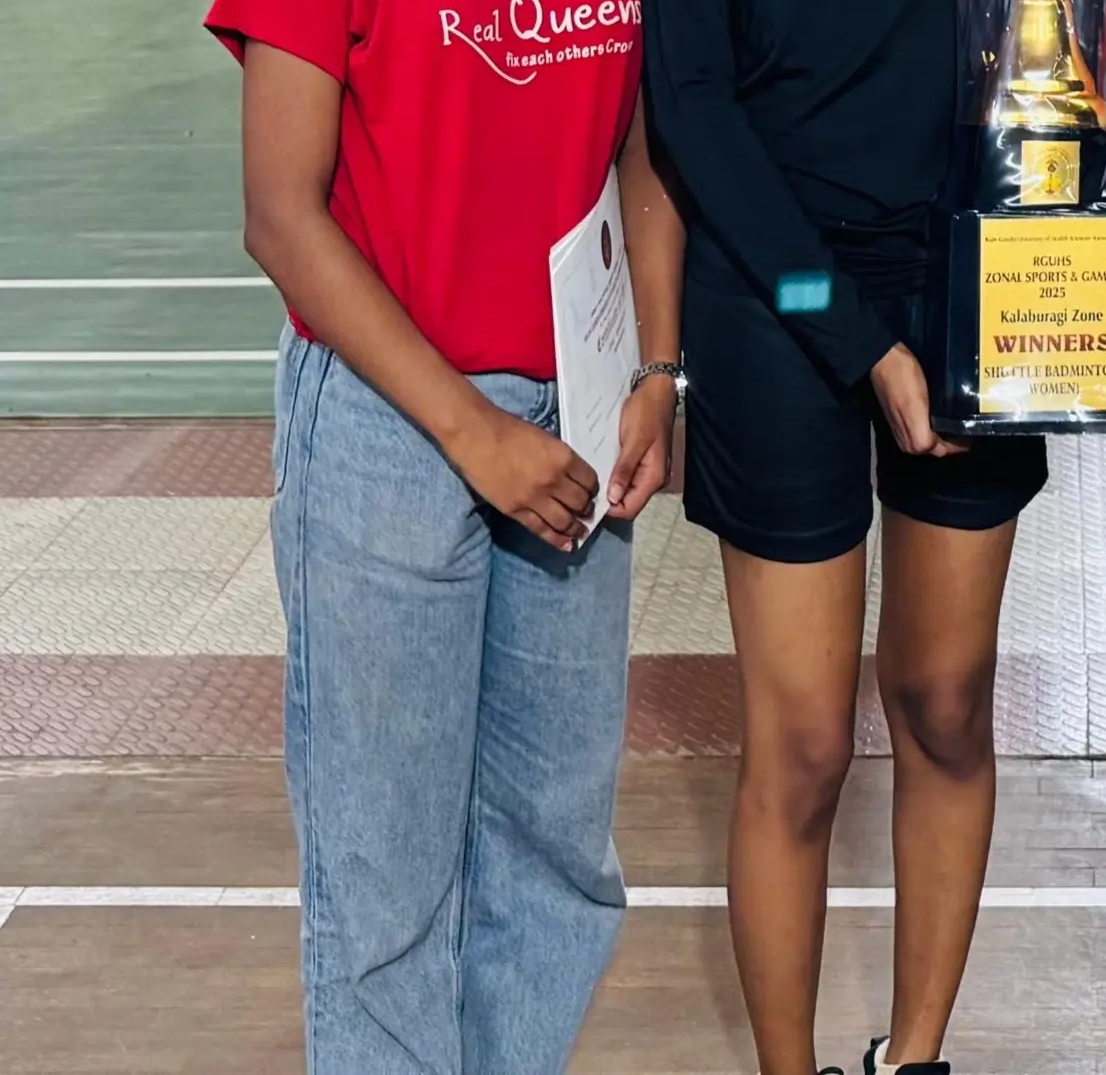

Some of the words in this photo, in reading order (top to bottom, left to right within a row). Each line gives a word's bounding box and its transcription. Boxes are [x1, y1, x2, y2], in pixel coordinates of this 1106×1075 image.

[506, 51, 520, 67] fix
[522, 49, 554, 67] each
[556, 44, 605, 63] others
[1033, 256, 1072, 267] RGUHS
[985, 272, 1022, 283] ZONAL
[1025, 271, 1067, 283] SPORTS
[1071, 271, 1077, 282] &
[1039, 287, 1066, 299] 2025
[1001, 309, 1068, 326] Kalaburagi
[1072, 309, 1104, 322] Zone
